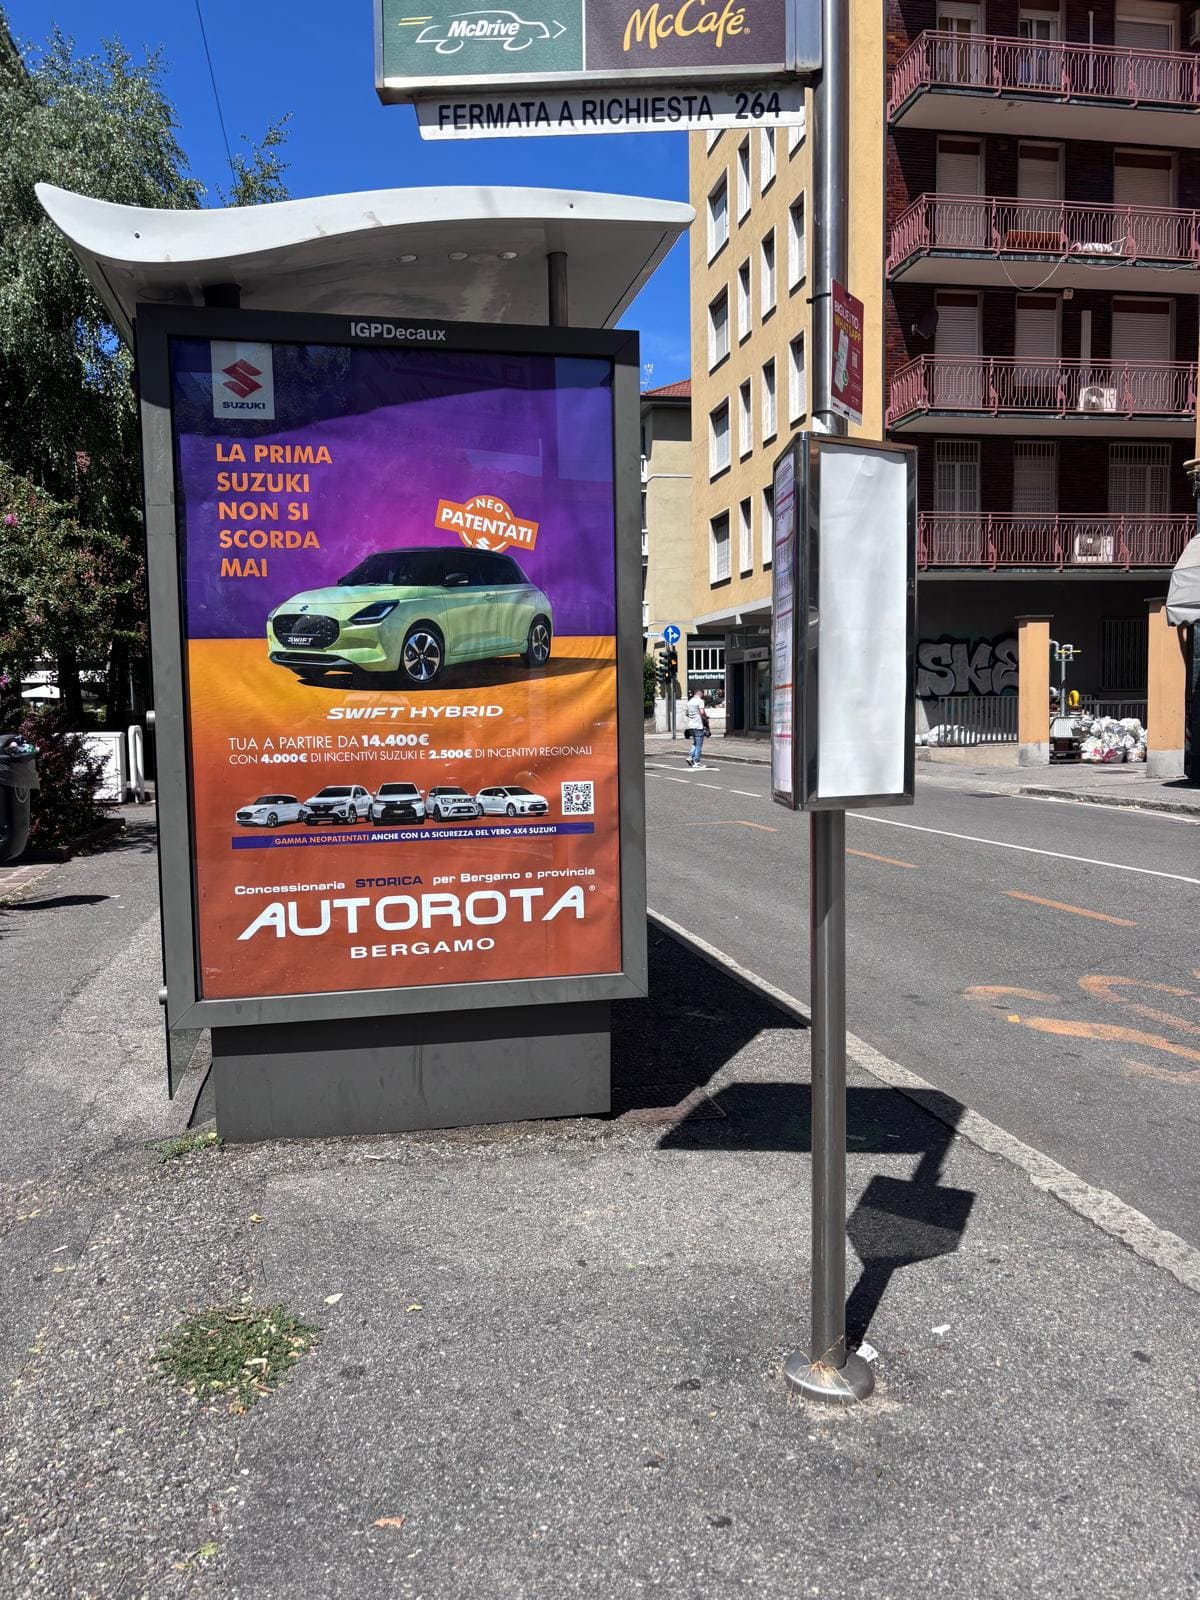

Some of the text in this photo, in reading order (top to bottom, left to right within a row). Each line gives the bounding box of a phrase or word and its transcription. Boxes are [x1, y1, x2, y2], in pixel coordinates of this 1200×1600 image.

[447, 20, 520, 38] McDrive
[623, 0, 746, 51] McCafé
[438, 92, 782, 131] FERMATA A RICHIESTA 264
[350, 322, 447, 341] IGPDecaux
[222, 401, 266, 410] SUZUKI
[215, 443, 333, 464] LA PRIMA
[216, 472, 310, 493] SUZUKI
[218, 501, 309, 521] NON SI
[475, 498, 504, 513] NEO
[441, 507, 533, 543] PATENTATI
[219, 529, 321, 549] SCORDA
[220, 558, 268, 577] MAI
[327, 705, 503, 720] SWIFT HYBRID
[228, 733, 430, 750] TUA A PARTIRE DA 14.400€
[229, 746, 592, 765] CON 4.000€ DI INCENTIVI SUZUKI E 2.500€ DI INCENTIVI REGIONALI
[274, 837, 307, 845] GAMMA
[309, 834, 370, 843] NEOPATENTATI
[371, 833, 399, 841] ANCHE
[400, 832, 419, 840] CON
[420, 831, 430, 839] LA
[432, 830, 474, 838] SICUREZZA
[529, 826, 556, 834] SUZUKI
[234, 867, 596, 895] Concessionaria STORICA per Bergamo e provincia
[236, 885, 586, 941] AUTOROTA
[350, 937, 496, 959] BERGAMO
